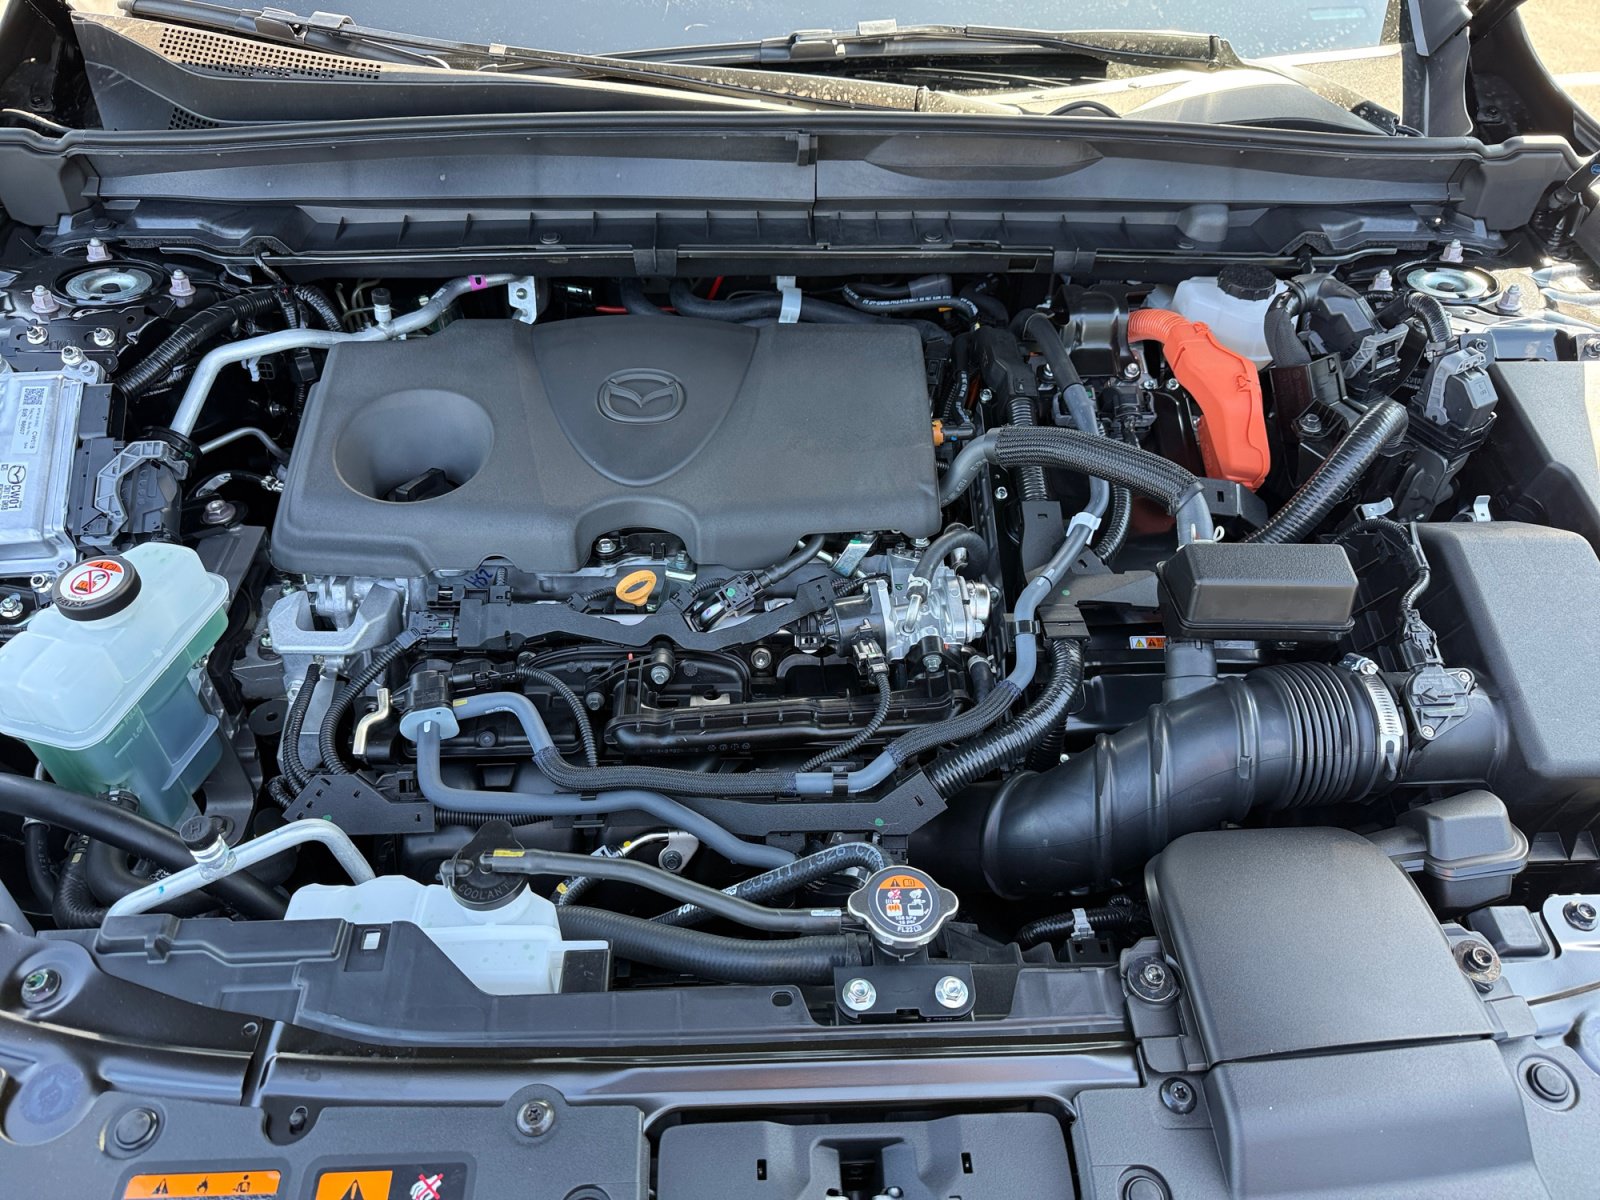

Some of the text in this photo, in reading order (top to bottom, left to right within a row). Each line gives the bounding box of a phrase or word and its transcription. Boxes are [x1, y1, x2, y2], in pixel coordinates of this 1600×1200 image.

[9, 485, 22, 509] CW01
[190, 822, 202, 834] H
[457, 881, 511, 901] COOLANT
